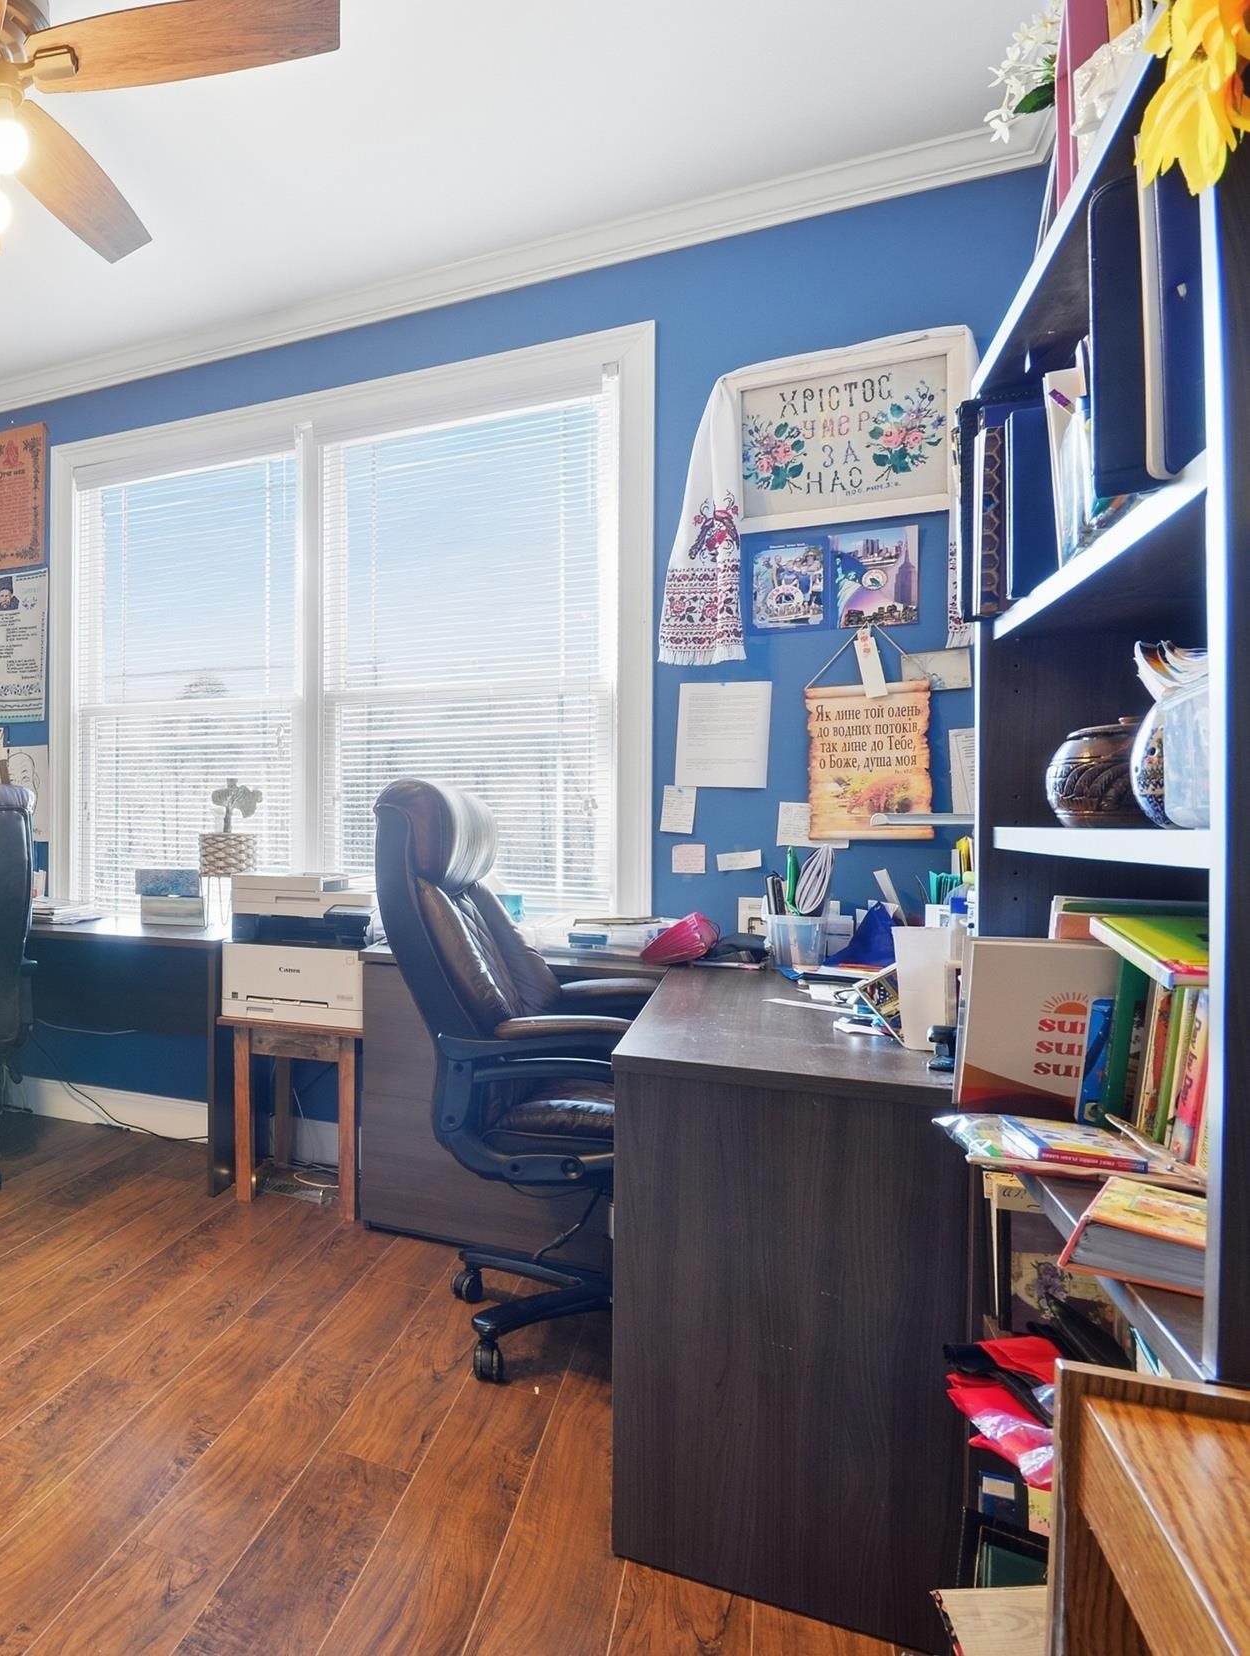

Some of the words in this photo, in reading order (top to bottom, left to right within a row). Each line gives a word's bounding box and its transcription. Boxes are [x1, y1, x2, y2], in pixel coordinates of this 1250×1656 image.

[815, 705, 831, 721] Як
[835, 709, 861, 720] лине
[864, 705, 884, 719] той
[888, 705, 921, 718] олень
[817, 727, 830, 738] до
[833, 725, 871, 737] водних
[820, 742, 838, 753] так
[841, 740, 867, 752] лине
[871, 739, 884, 752] до
[819, 758, 826, 769] о
[830, 754, 861, 771] Боже,
[863, 756, 892, 772] душа
[895, 755, 917, 766] моя
[278, 967, 301, 975] Canon
[1191, 1018, 1202, 1049] Day
[1187, 1051, 1198, 1072] by
[1181, 1074, 1193, 1107] Day
